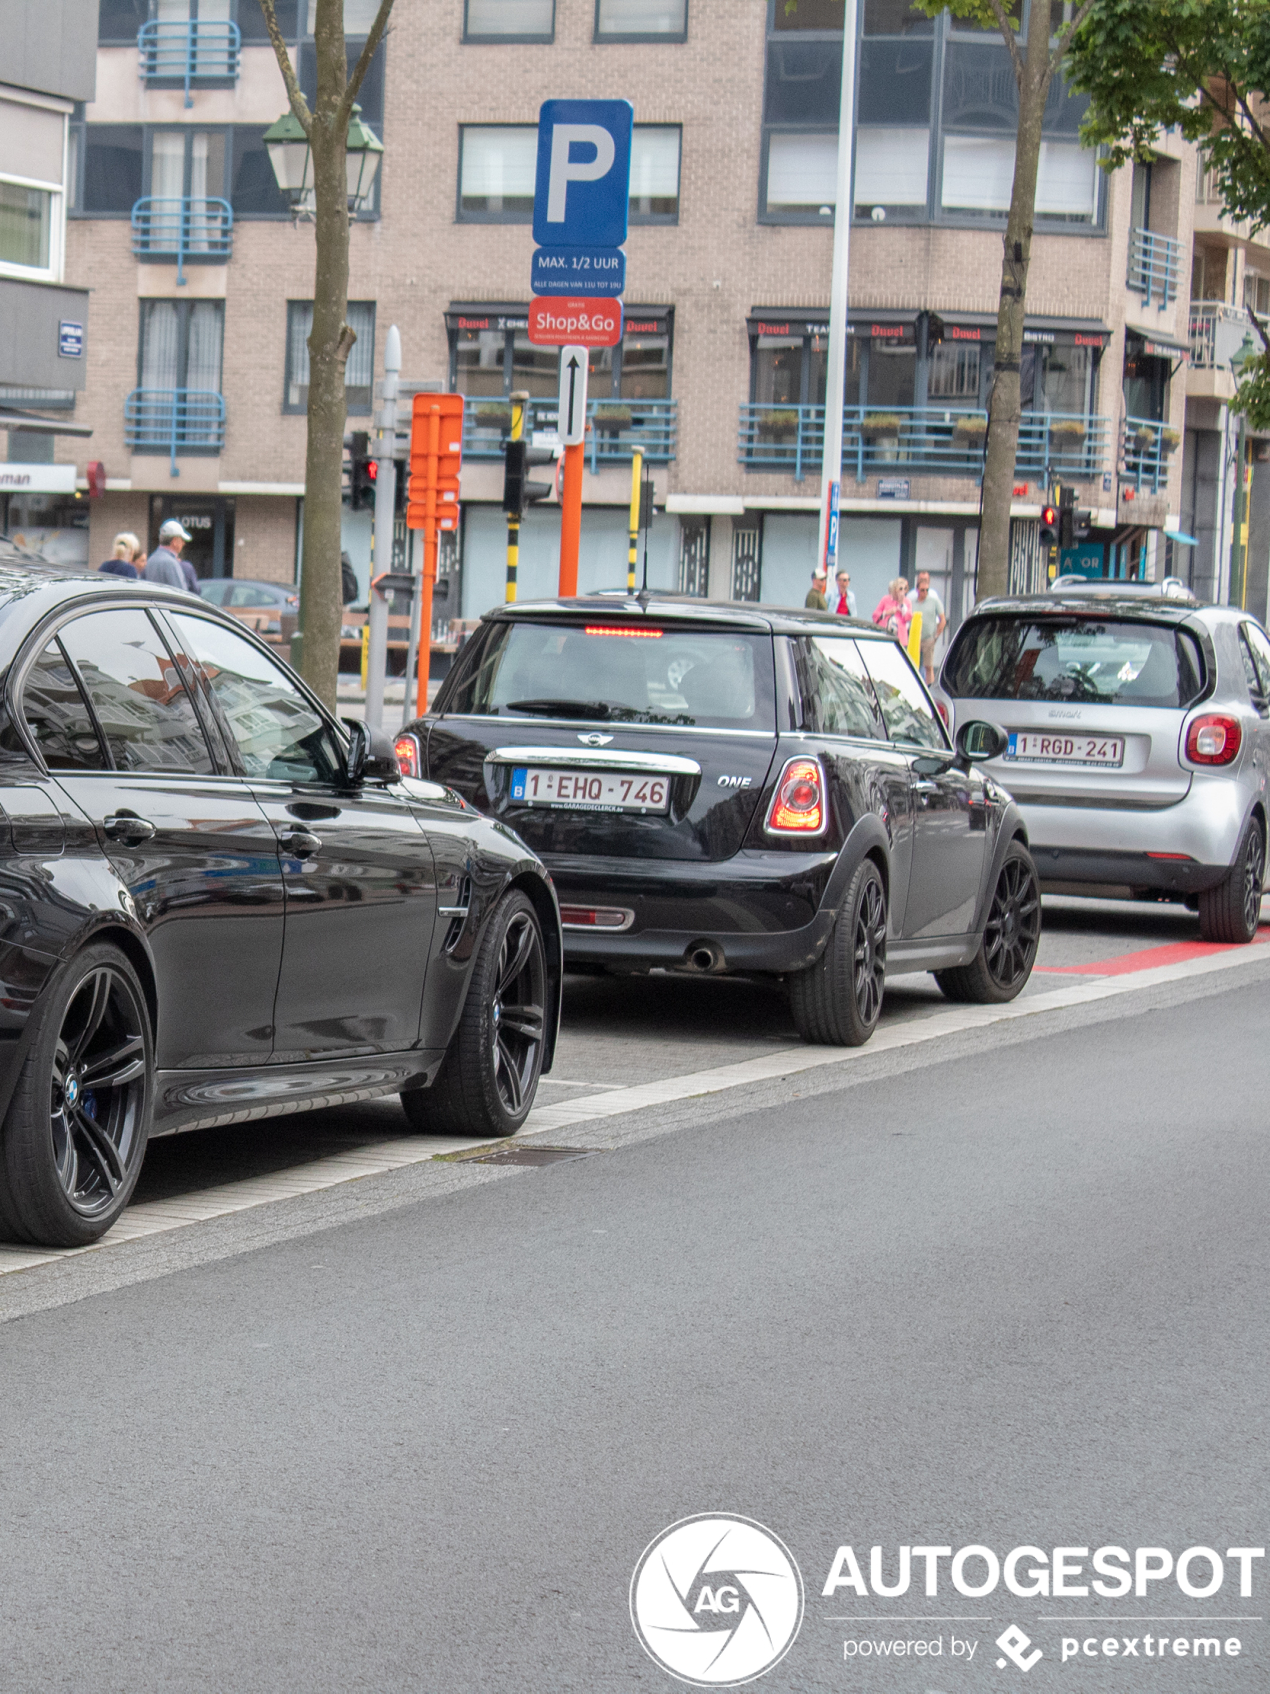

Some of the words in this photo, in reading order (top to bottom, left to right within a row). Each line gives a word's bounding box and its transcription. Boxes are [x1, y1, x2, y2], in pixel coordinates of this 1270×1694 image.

[547, 124, 615, 223] P
[538, 257, 568, 269] MAX.
[571, 256, 590, 270] 1/2
[593, 257, 619, 269] UUR
[584, 281, 596, 289] 11U
[458, 316, 489, 329] Duvel
[536, 312, 615, 333] Shop&Go
[626, 320, 658, 332] Duvel
[757, 322, 789, 335] Duvel
[871, 324, 903, 337] Duvel
[952, 326, 980, 339] Duvel
[1074, 333, 1103, 346] Duvel
[1048, 709, 1082, 719] smart
[1020, 737, 1118, 759] 1-RGD-241
[514, 785, 523, 798] B
[530, 774, 664, 803] 1-EHQ-746
[717, 775, 752, 789] ONE
